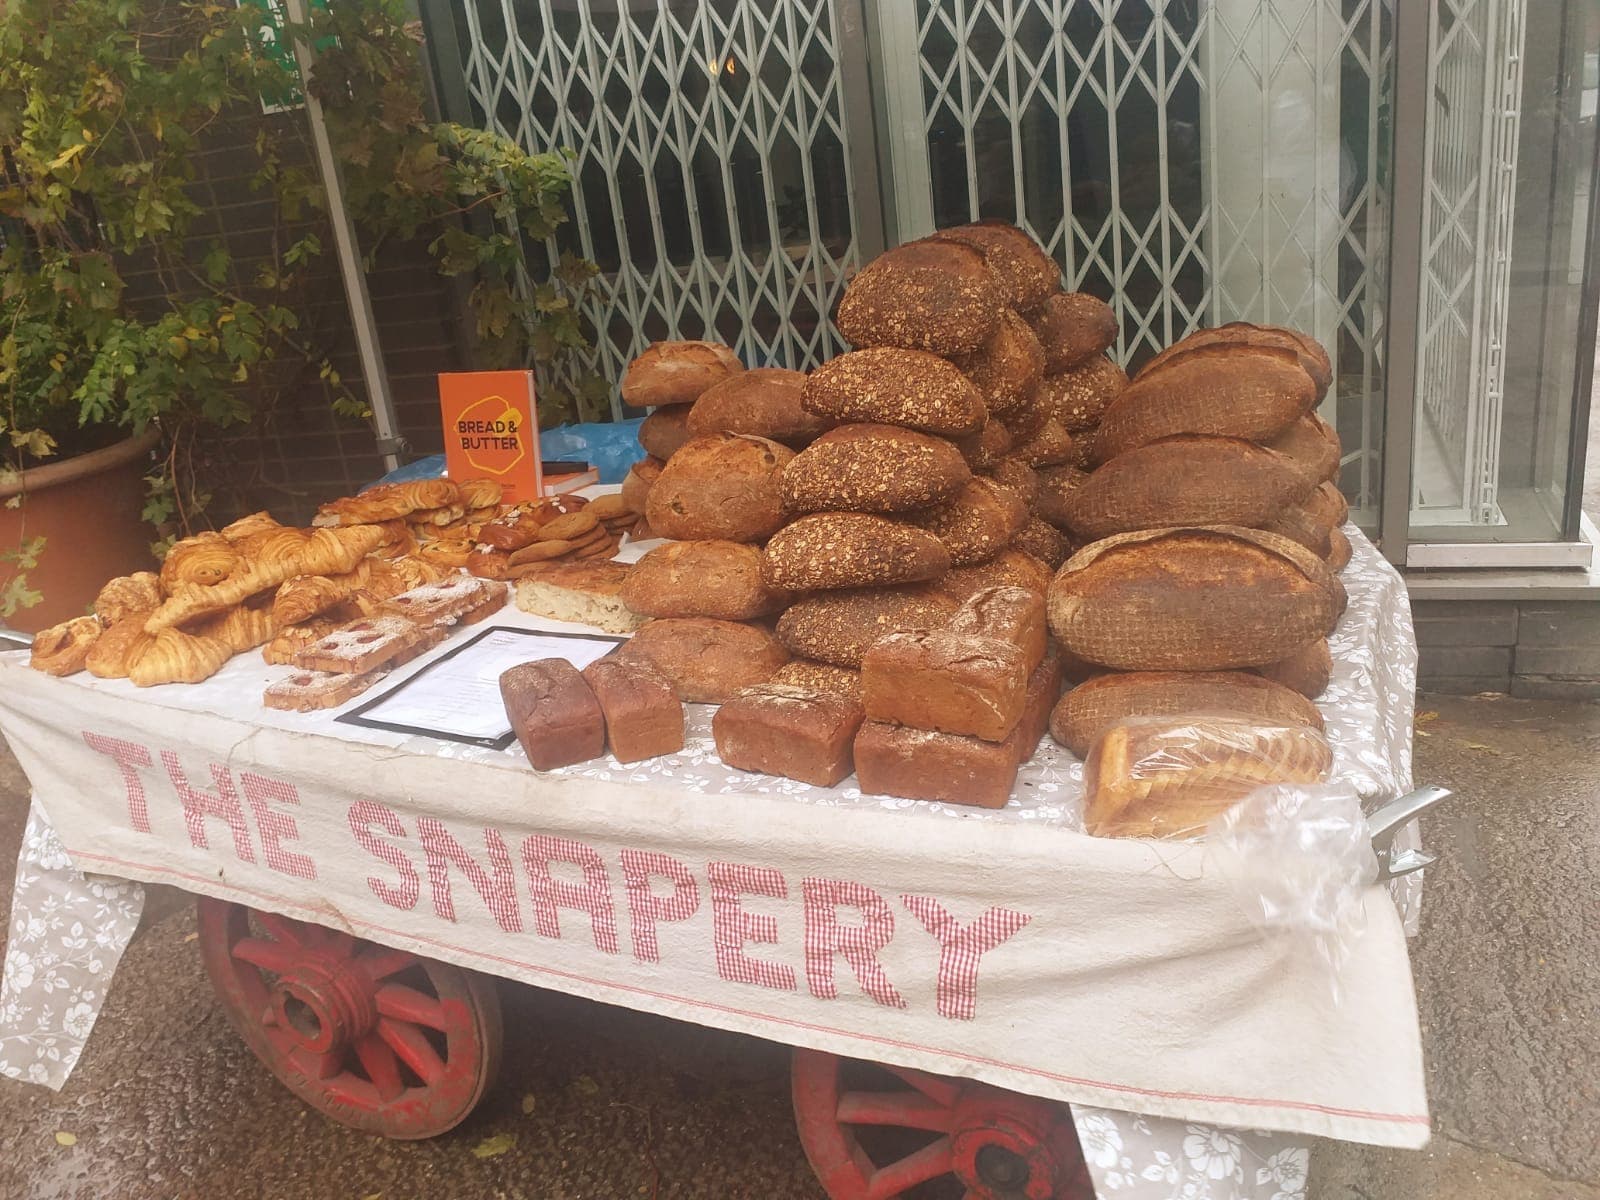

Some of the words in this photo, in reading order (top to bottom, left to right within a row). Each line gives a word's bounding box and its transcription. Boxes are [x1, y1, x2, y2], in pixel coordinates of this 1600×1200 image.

[458, 420, 506, 434] BREAD
[508, 420, 518, 433] &
[461, 437, 519, 450] BUTTER
[82, 731, 318, 880] THE
[347, 800, 1032, 1021] SNAPERY
